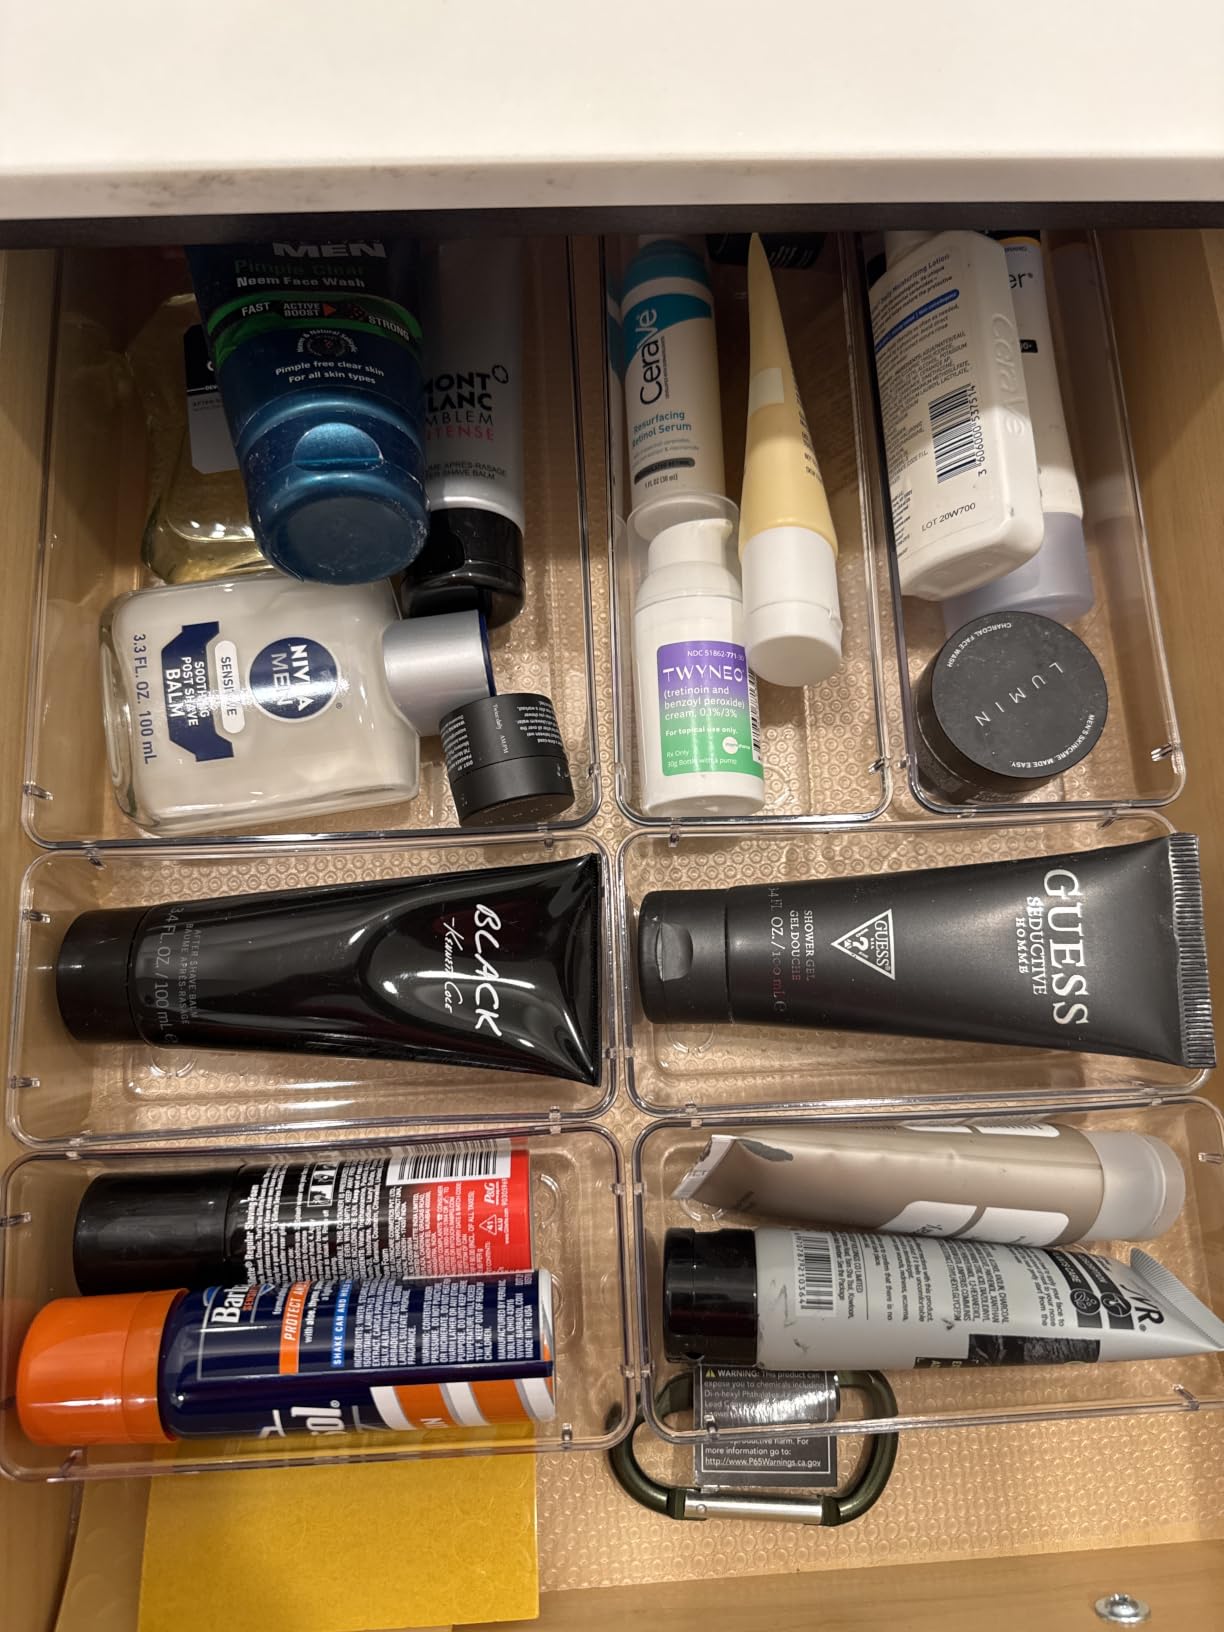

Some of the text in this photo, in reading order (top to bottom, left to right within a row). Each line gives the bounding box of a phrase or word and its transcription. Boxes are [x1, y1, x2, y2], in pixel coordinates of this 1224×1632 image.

[272, 242, 387, 258] MEN
[236, 276, 366, 288] Neem Face Wash
[241, 302, 271, 317] FAST
[283, 309, 320, 317] BOOST
[368, 315, 410, 342] STRONG
[275, 360, 385, 377] Pimple free clear skin
[635, 308, 663, 405] CeraVe
[288, 371, 376, 384] For all skin types
[428, 391, 492, 412] LANC
[425, 411, 493, 426] MBLEM
[633, 411, 685, 434] Resurfacing
[657, 423, 692, 434] Serum
[921, 502, 976, 532] LOT 20W700
[687, 650, 704, 658] NDC
[946, 622, 1012, 668] CHARCOAL FACE WASH
[290, 644, 316, 712] NIVA
[662, 664, 744, 682] TWYNEO
[133, 633, 157, 765] 3.3 FL. OZ. 100 mL
[166, 668, 186, 718] BALM
[182, 656, 199, 727] POST SHAVE
[194, 661, 210, 718] SOOTHG
[221, 656, 237, 717] SENSIVE
[664, 686, 730, 700] (tretinoin and
[974, 662, 1064, 727] LUMIN
[664, 697, 745, 711] benzoyl peroxide)
[664, 709, 697, 721] cream,
[678, 727, 706, 736] topical
[721, 727, 739, 736] only.
[1010, 714, 1096, 768] MEN'S SKINCARE. MADE EASY.
[677, 749, 689, 758] Only
[719, 758, 737, 767] pump
[160, 925, 177, 944] FL.
[180, 923, 194, 953] BAUME
[770, 916, 784, 939] OZ.
[789, 910, 801, 981] GEL DOUCHE
[804, 910, 816, 982] SHOWER GEL
[874, 920, 889, 967] GUESS
[1015, 917, 1030, 974] HOMME
[1026, 896, 1048, 996] SEDUCTIVE
[1043, 868, 1089, 1025] GUESS
[188, 928, 203, 1019] AFTER SHAVE BALM
[474, 903, 502, 1036] BLACK
[154, 982, 170, 1010] 100
[157, 1011, 174, 1031] mL
[484, 1182, 496, 1204] P&G
[244, 1184, 259, 1260] Regular Shaving Foam
[486, 1221, 493, 1231] 41
[381, 1248, 389, 1265] Foam
[337, 1298, 347, 1313] AND
[523, 1305, 532, 1317] USA
[887, 1312, 893, 1320] no
[999, 1292, 1009, 1324] CHARCOAL
[283, 1297, 300, 1341] PROTECT
[304, 1307, 316, 1343] with aloe,
[335, 1315, 344, 1333] CAN
[475, 1311, 483, 1340] KEEP OUT
[507, 1316, 515, 1331] OHIO
[515, 1293, 524, 1359] WWW.BARBASOL.COM
[524, 1318, 532, 1330] THE
[354, 1325, 363, 1368] INGREDIENTS:
[381, 1330, 389, 1347] ALBA
[408, 1325, 416, 1364] FRAGRANCE.
[431, 1317, 440, 1363] PRESSURE. DO
[448, 1308, 457, 1362] WARM LATHER OR
[466, 1317, 475, 1361] TEMPERATURE
[484, 1326, 492, 1360] CHILDREN.
[498, 1309, 506, 1359] MANUFACTURED
[333, 1335, 343, 1366] SHAKE
[422, 1331, 430, 1364] WARNING:
[440, 1352, 448, 1363] OR
[524, 1339, 533, 1358] MADE
[704, 1381, 730, 1389] expose
[755, 1380, 791, 1388] chemicals
[792, 1380, 826, 1389] including
[718, 1369, 759, 1378] WARNING:
[778, 1371, 806, 1380] product
[705, 1457, 821, 1467] http://www.P65Warnings.ca.gov
[726, 1447, 768, 1455] information
[769, 1449, 779, 1457] go
